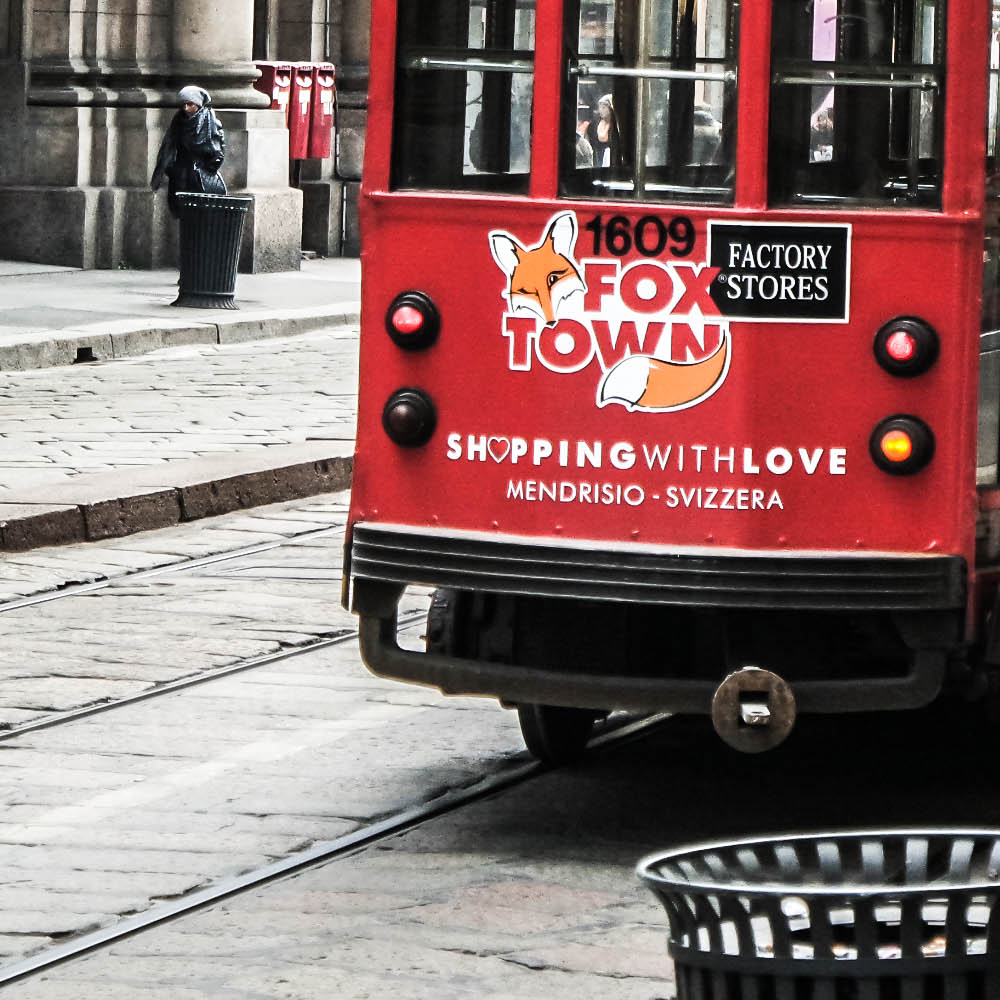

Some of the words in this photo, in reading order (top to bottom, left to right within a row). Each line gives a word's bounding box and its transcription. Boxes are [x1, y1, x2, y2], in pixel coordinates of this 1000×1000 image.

[586, 215, 695, 257] 1609
[728, 243, 831, 270] FACTORY
[583, 261, 723, 317] FOX
[726, 275, 830, 301] STORES
[505, 317, 722, 372] TOWN
[506, 479, 644, 506] MENDRISIO
[666, 486, 784, 510] SVIZZERA
